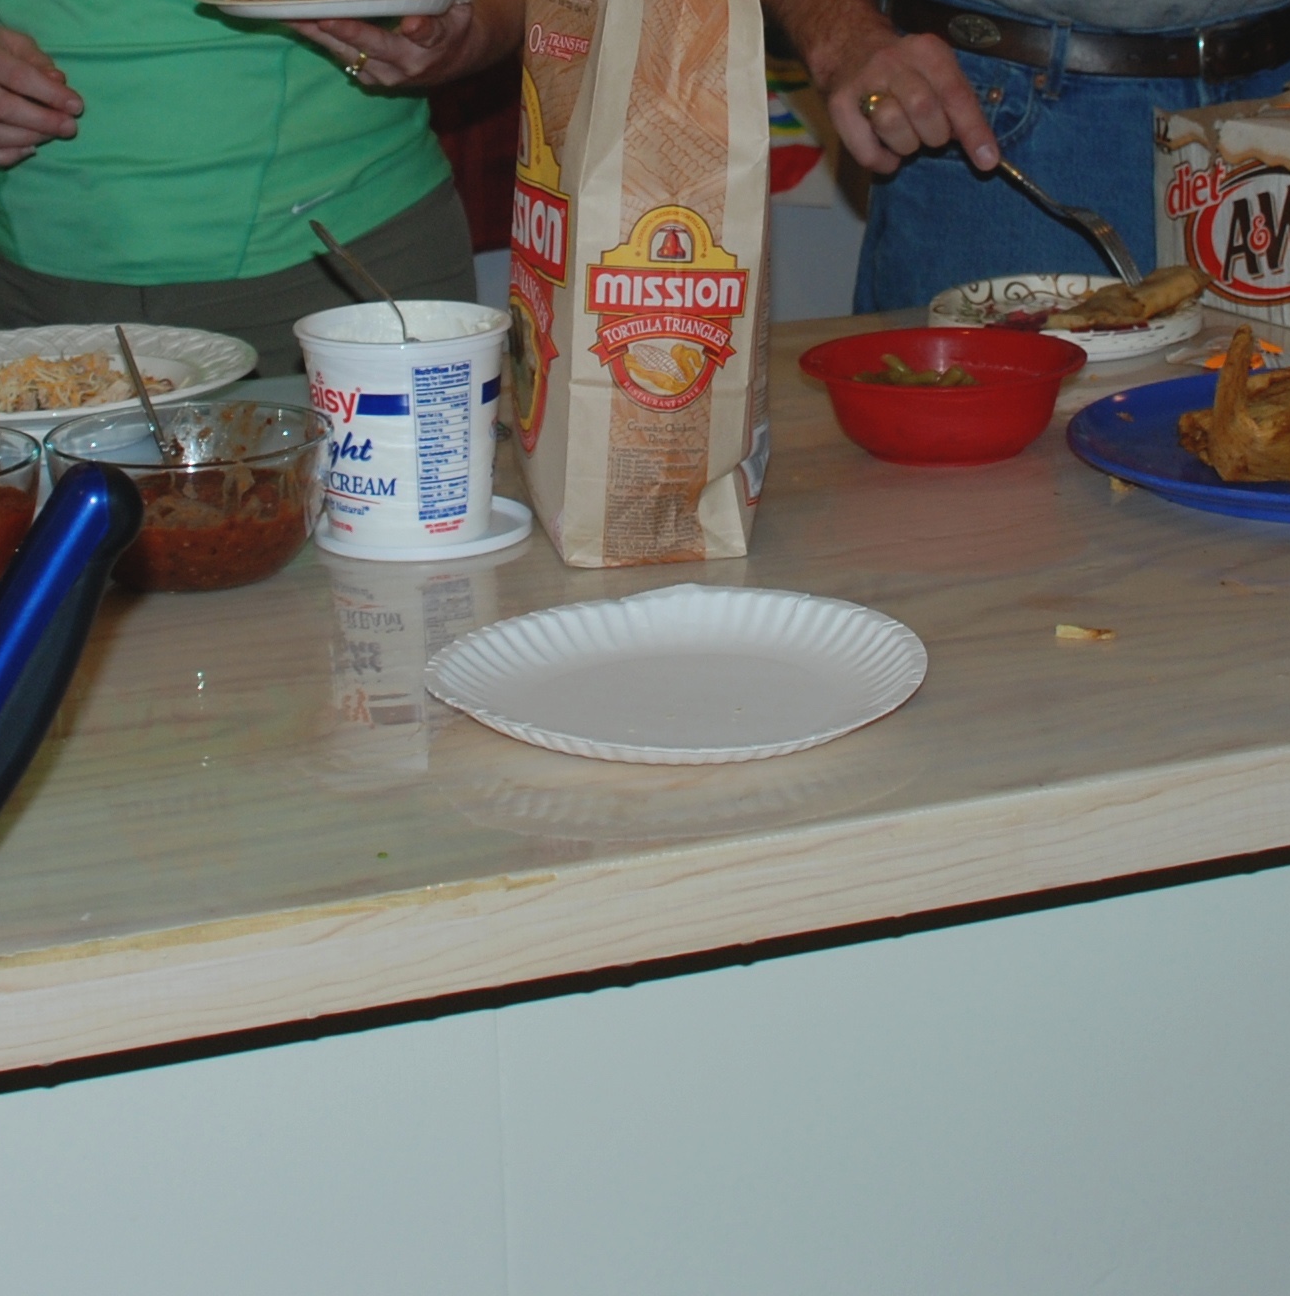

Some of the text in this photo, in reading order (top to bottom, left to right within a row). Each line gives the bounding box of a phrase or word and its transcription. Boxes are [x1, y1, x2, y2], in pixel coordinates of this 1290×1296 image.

[1168, 161, 1225, 215] diet
[511, 186, 563, 266] SSION
[595, 272, 741, 308] MISSION
[603, 315, 729, 347] TORTILLA TRIANGLES
[309, 384, 356, 424] aisy
[329, 431, 373, 471] ght
[329, 471, 397, 497] CREAM
